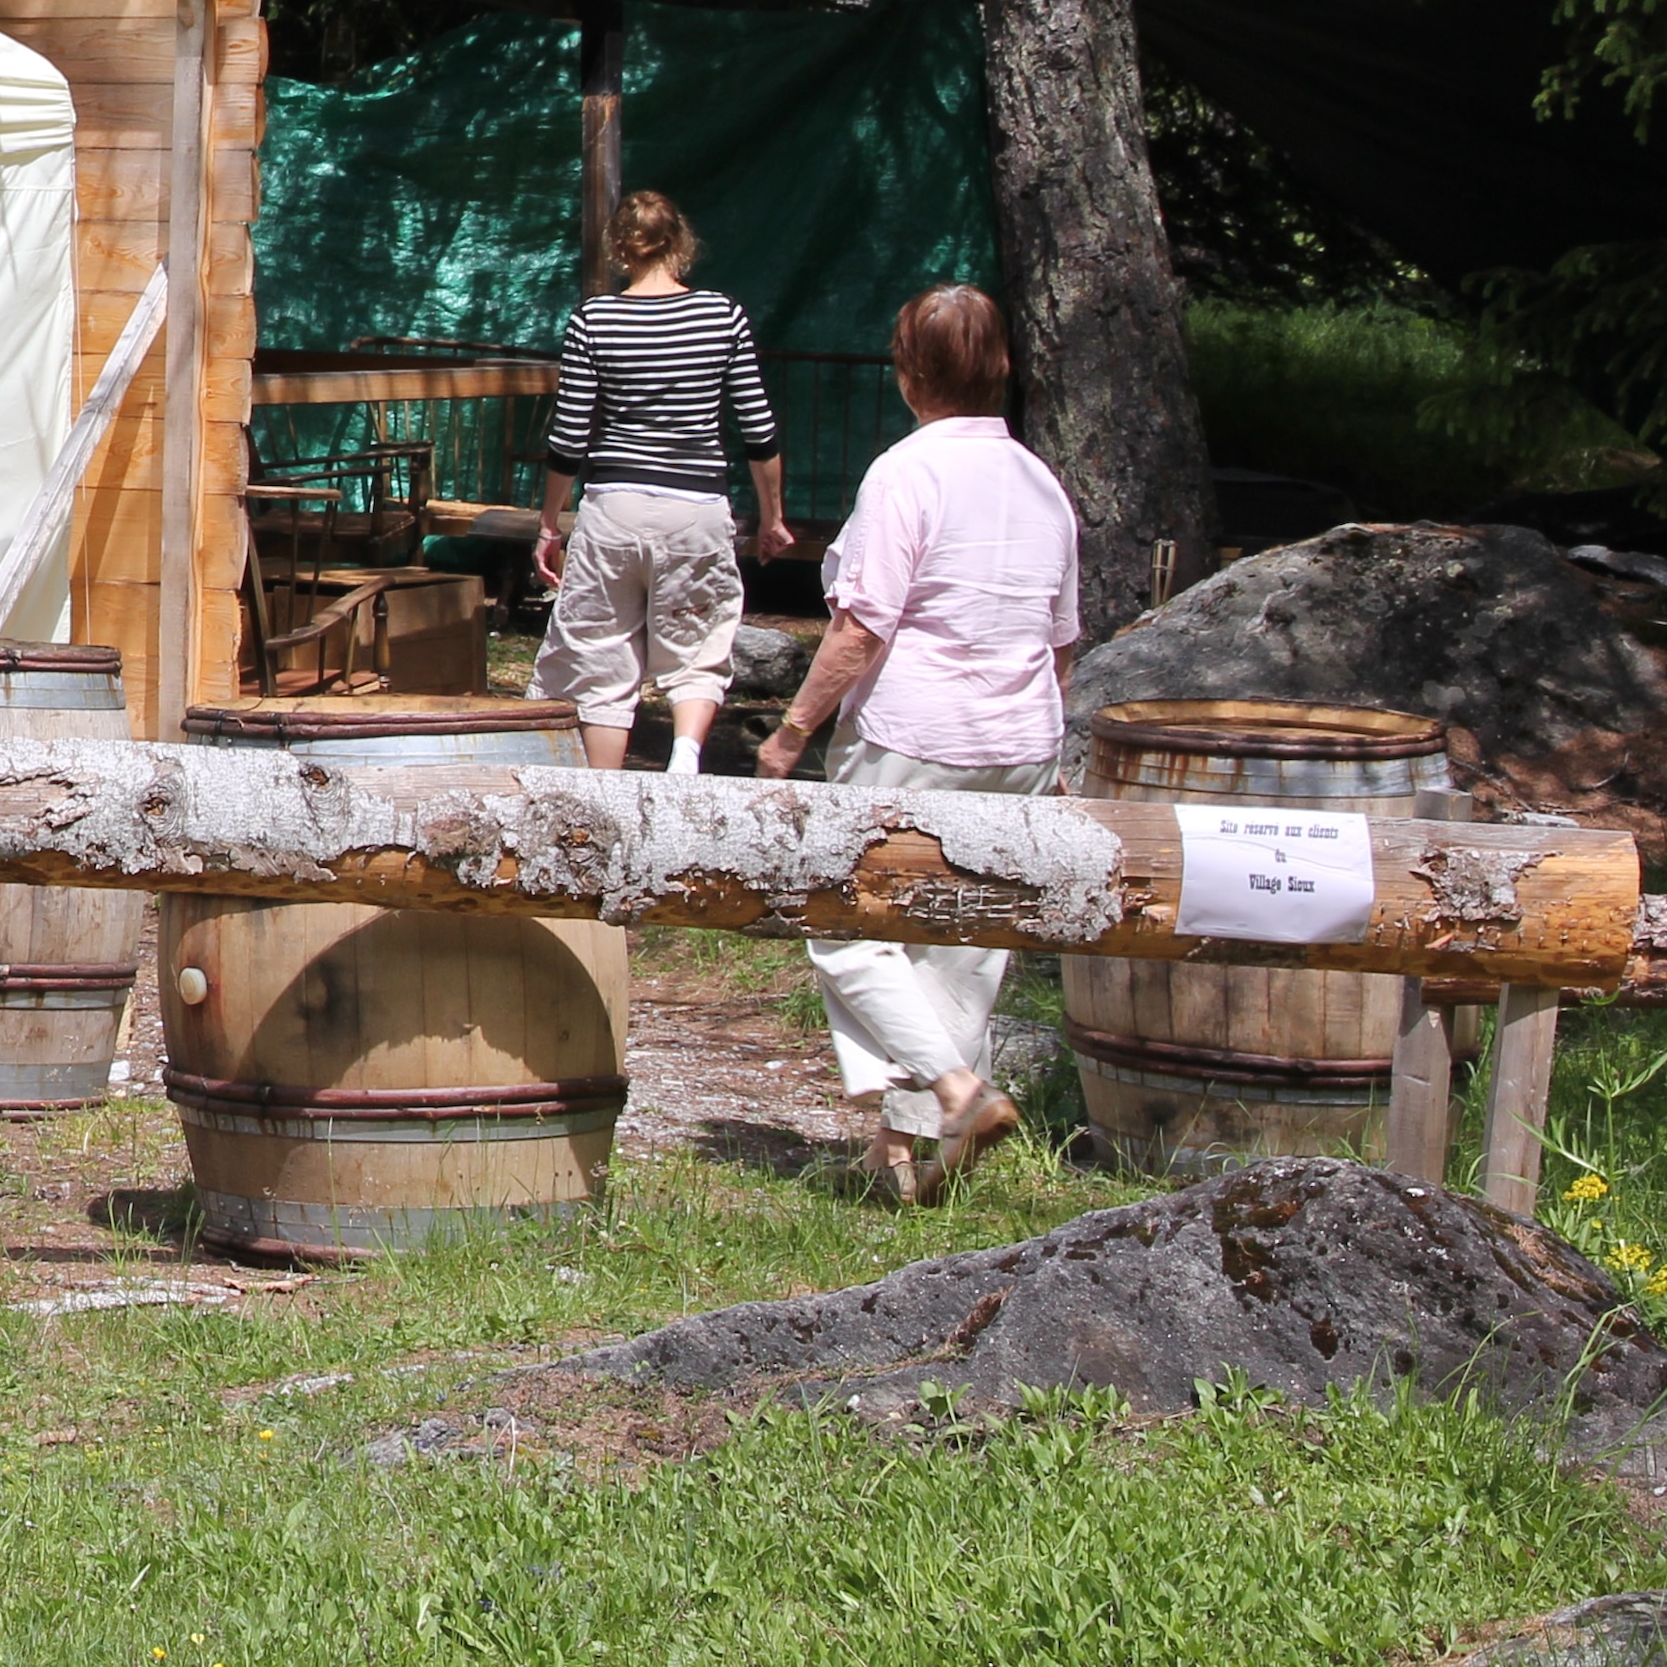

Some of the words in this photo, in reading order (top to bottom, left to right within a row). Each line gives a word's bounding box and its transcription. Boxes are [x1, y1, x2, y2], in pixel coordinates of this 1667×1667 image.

[1285, 825, 1302, 837] aux
[1308, 824, 1339, 839] clients
[1275, 849, 1286, 863] du
[1249, 874, 1281, 894] Village
[1288, 877, 1315, 893] Sioux
